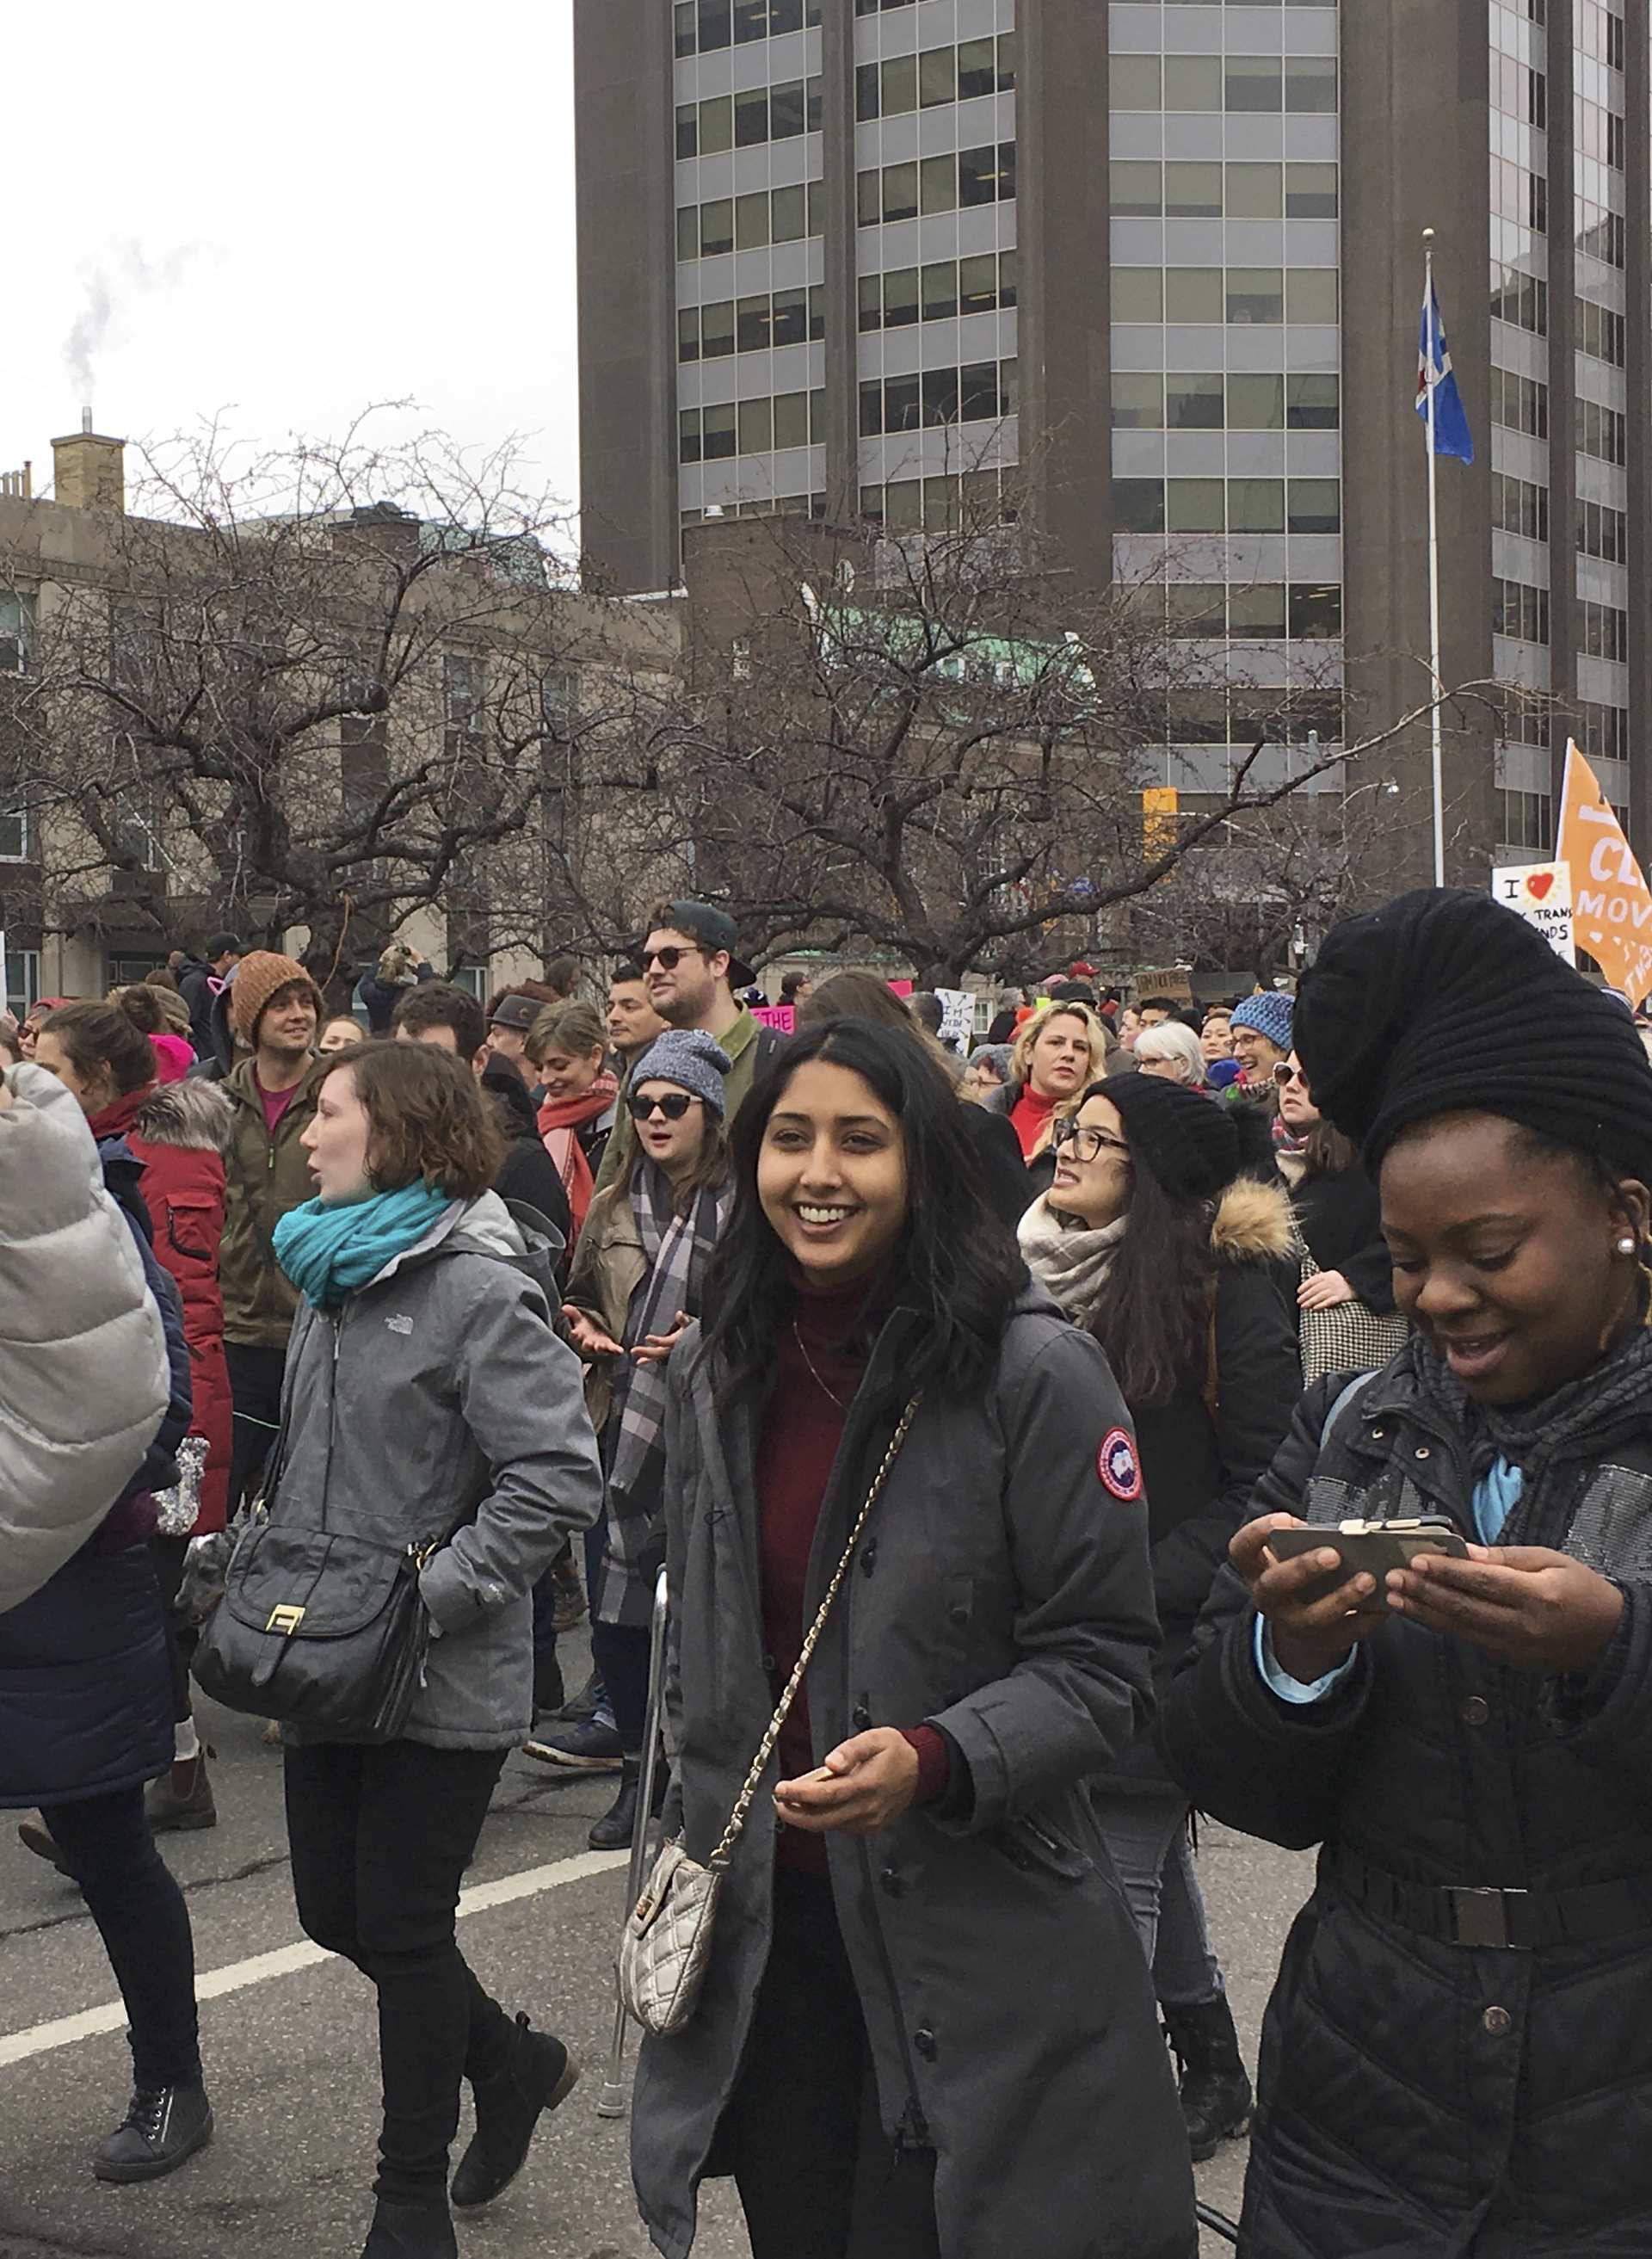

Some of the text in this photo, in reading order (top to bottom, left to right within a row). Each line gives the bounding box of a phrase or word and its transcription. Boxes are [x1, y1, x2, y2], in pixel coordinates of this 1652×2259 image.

[1590, 836, 1648, 891] CL
[1504, 880, 1519, 898] I
[1575, 890, 1652, 929] MOV
[761, 1011, 791, 1030] THE
